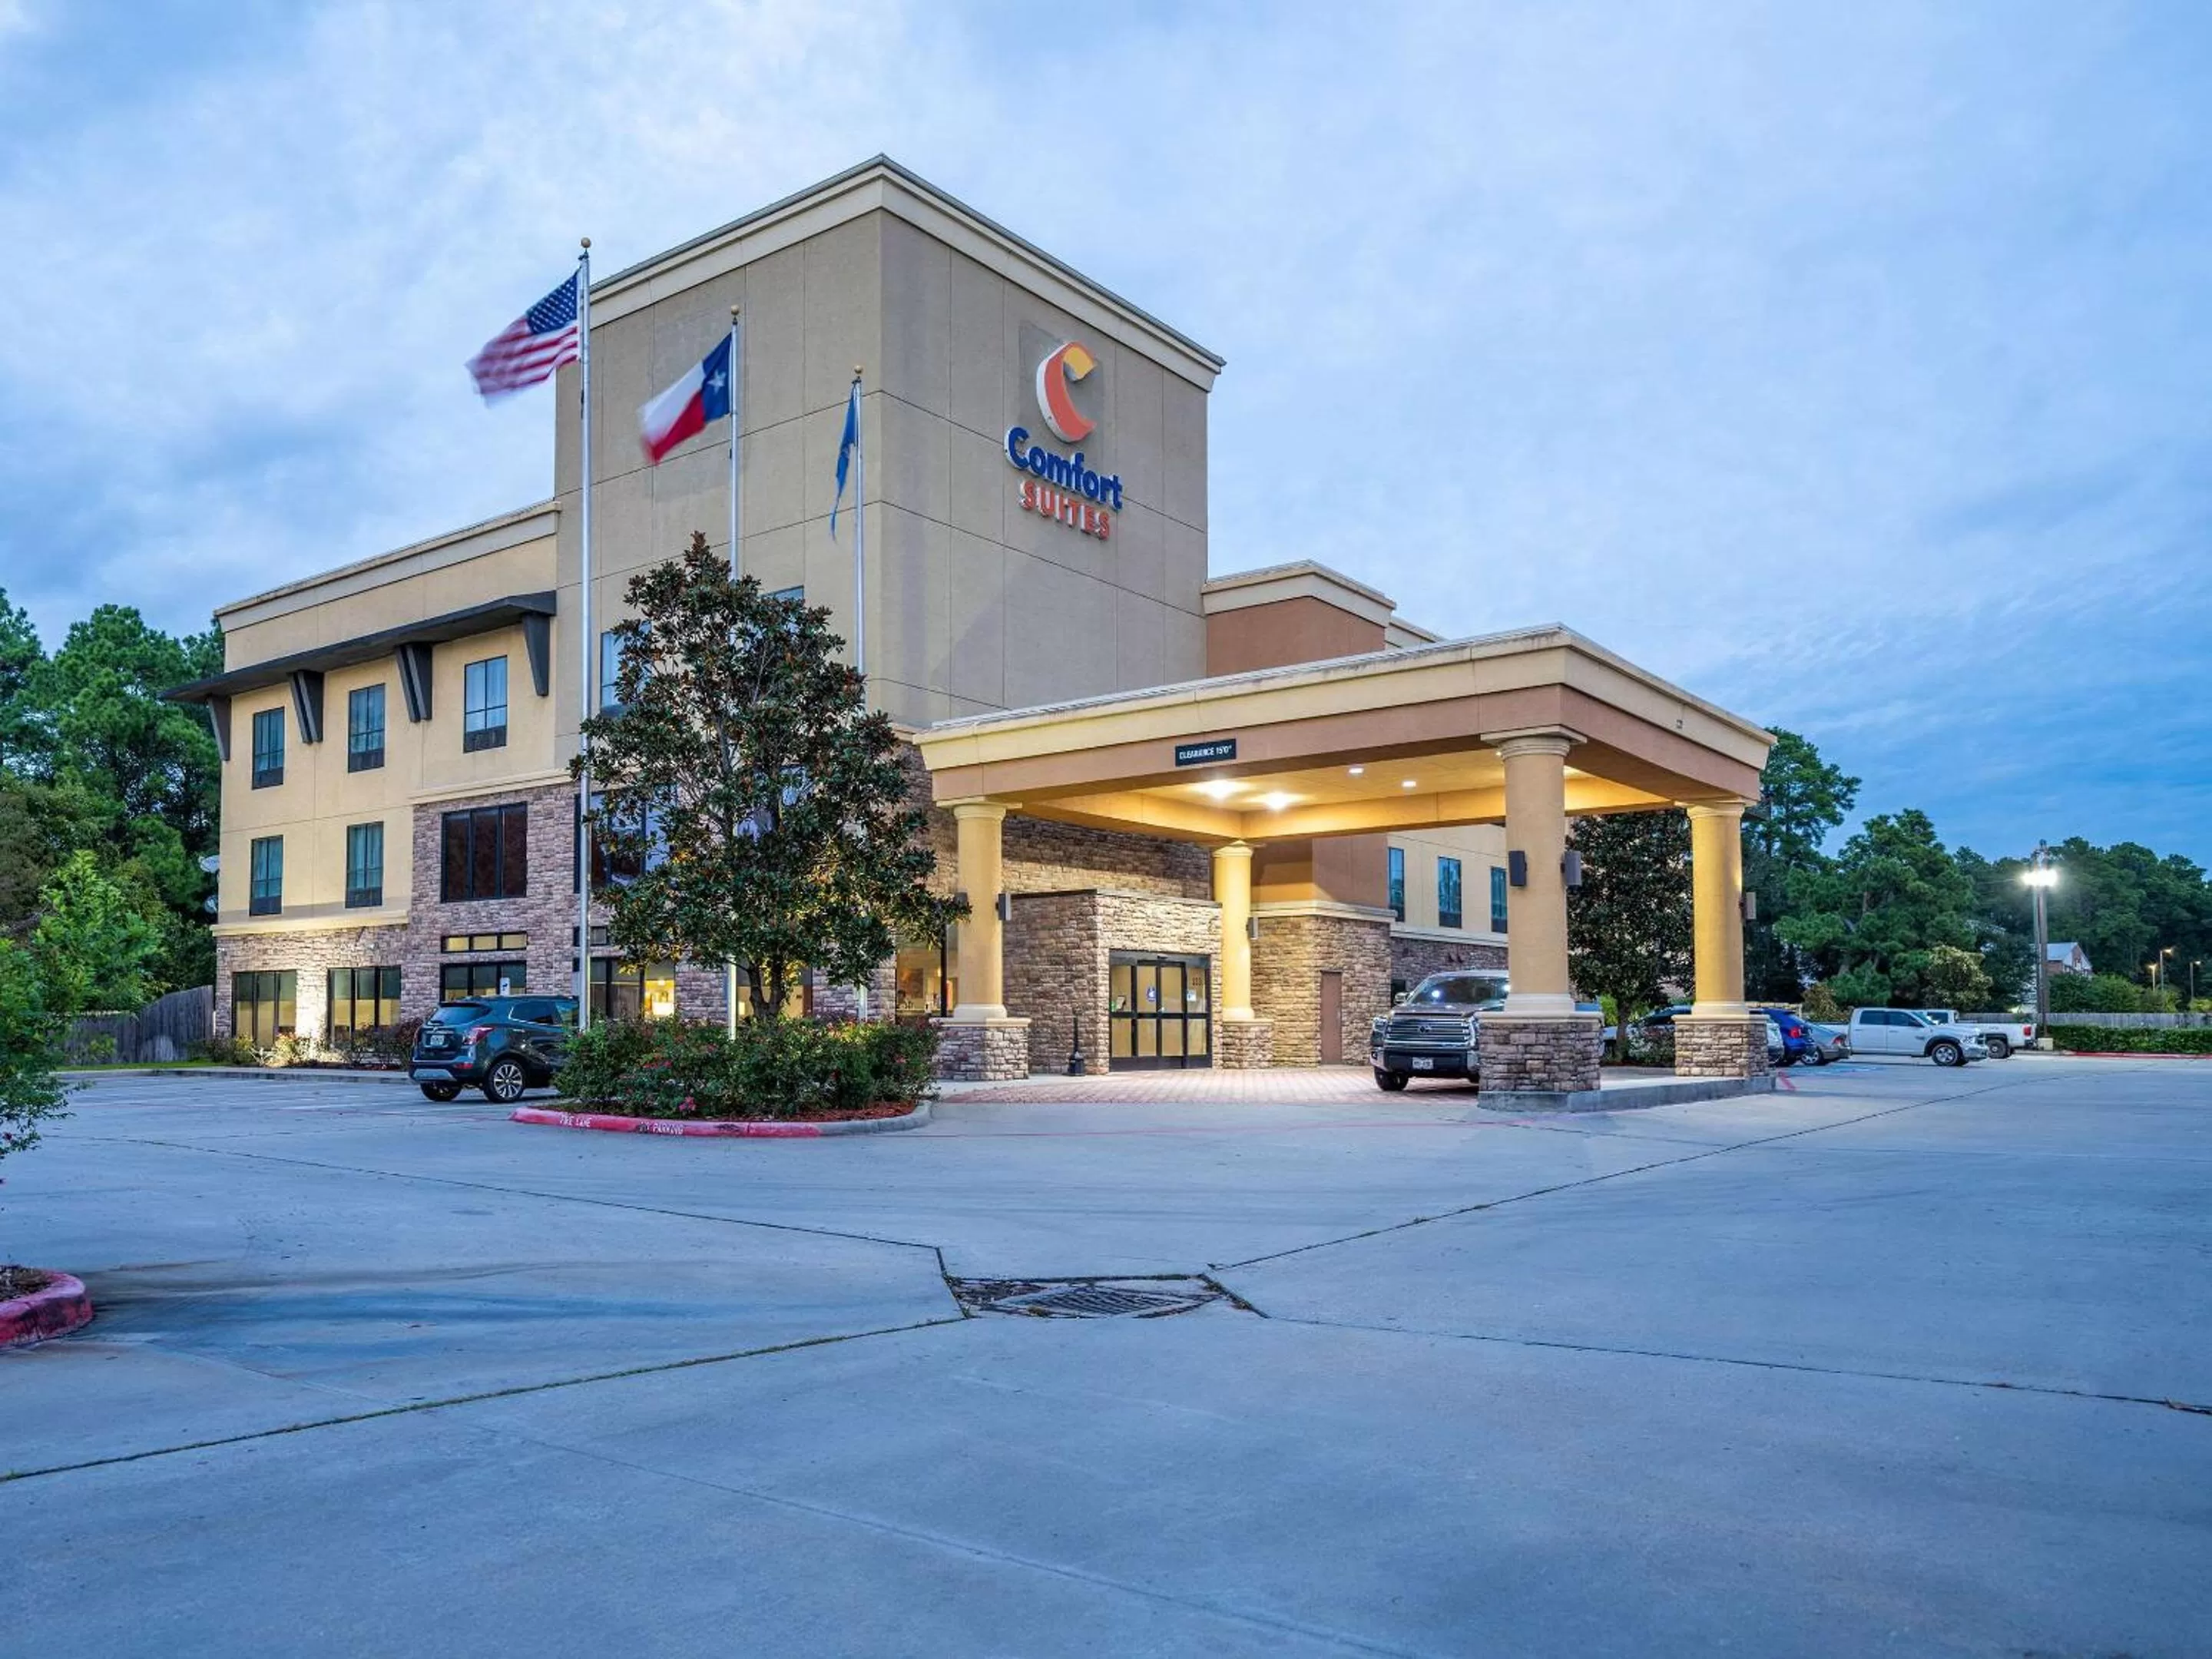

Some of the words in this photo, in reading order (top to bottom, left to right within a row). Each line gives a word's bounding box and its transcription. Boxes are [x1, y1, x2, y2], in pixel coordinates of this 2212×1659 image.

[1004, 426, 1123, 511] Comfort
[1019, 478, 1110, 541] SUITES
[1179, 747, 1214, 760] CLEARANCE
